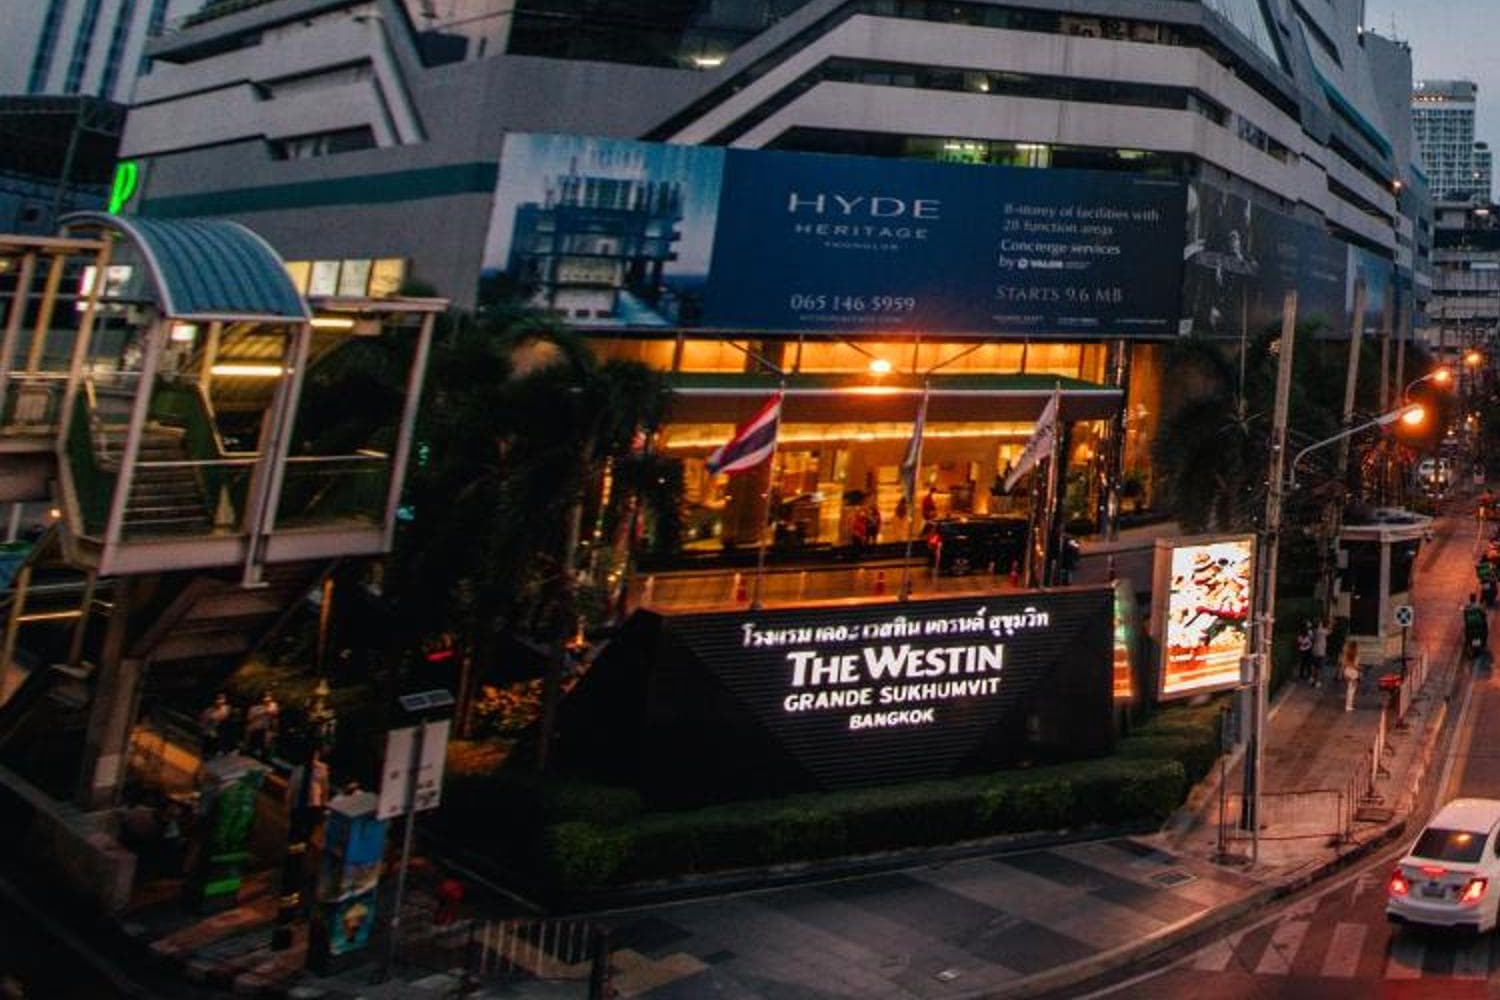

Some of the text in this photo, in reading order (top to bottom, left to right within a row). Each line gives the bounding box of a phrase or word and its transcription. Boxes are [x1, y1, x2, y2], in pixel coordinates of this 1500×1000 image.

[787, 192, 943, 220] HYDE
[1059, 204, 1074, 217] of
[1076, 205, 1130, 220] facilities
[1131, 207, 1160, 222] with
[795, 223, 929, 240] HERITAGE
[1023, 220, 1078, 234] function
[1080, 223, 1114, 237] areas
[1000, 239, 1122, 256] Concierge services
[998, 254, 1015, 270] by
[789, 294, 917, 312] 065 146 5959
[996, 286, 1060, 302] STARTS
[786, 644, 1004, 687] THE WESTIN
[783, 677, 1002, 712] GRANDE SUKHUMVIT
[848, 707, 935, 730] BANGKOK
